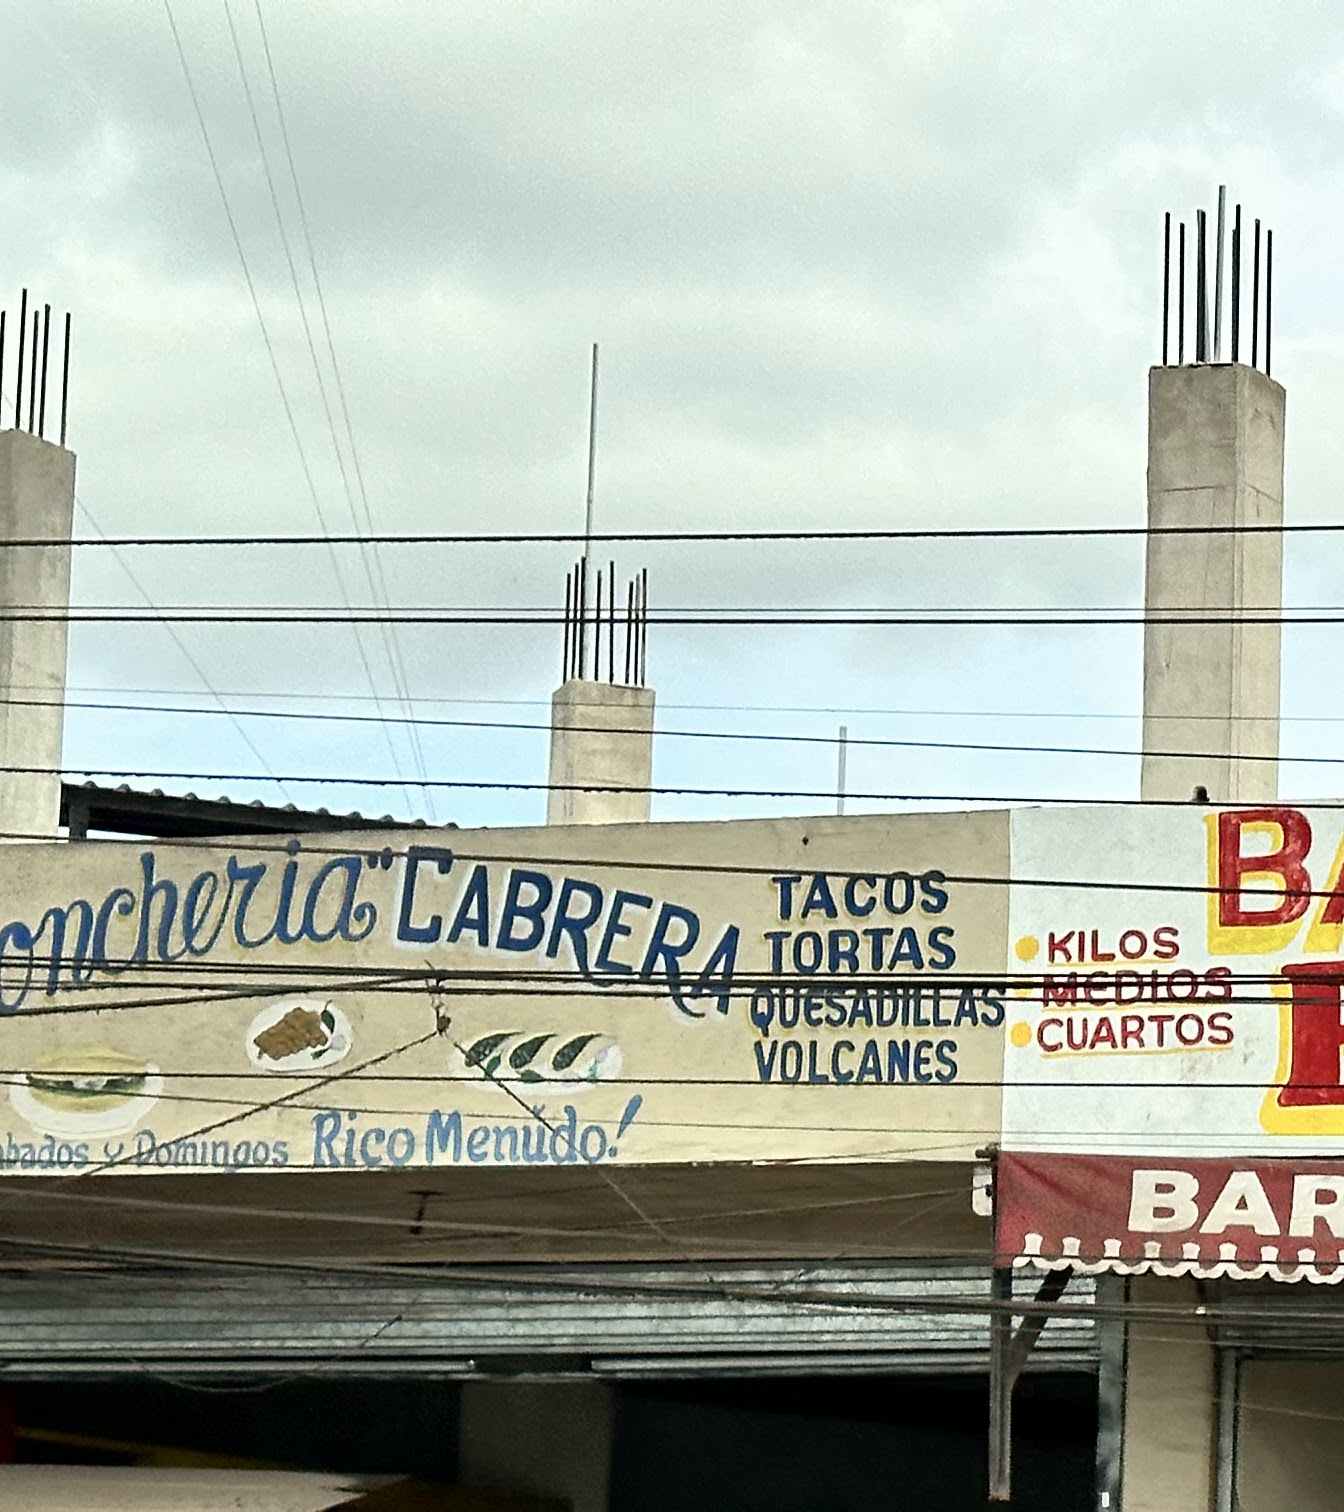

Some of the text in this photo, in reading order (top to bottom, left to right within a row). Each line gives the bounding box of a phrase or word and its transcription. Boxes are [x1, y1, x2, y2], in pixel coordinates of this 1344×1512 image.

[771, 870, 949, 920] TACOS
[764, 926, 957, 975] TORTAS
[1048, 927, 1180, 963] KILOS
[750, 983, 1006, 1037] QUESADILLAS
[1043, 967, 1231, 1007] MEDIOS
[1037, 1012, 1234, 1051] CUARTOS
[754, 1039, 958, 1085] VOLCANES
[311, 1110, 415, 1166] Rico
